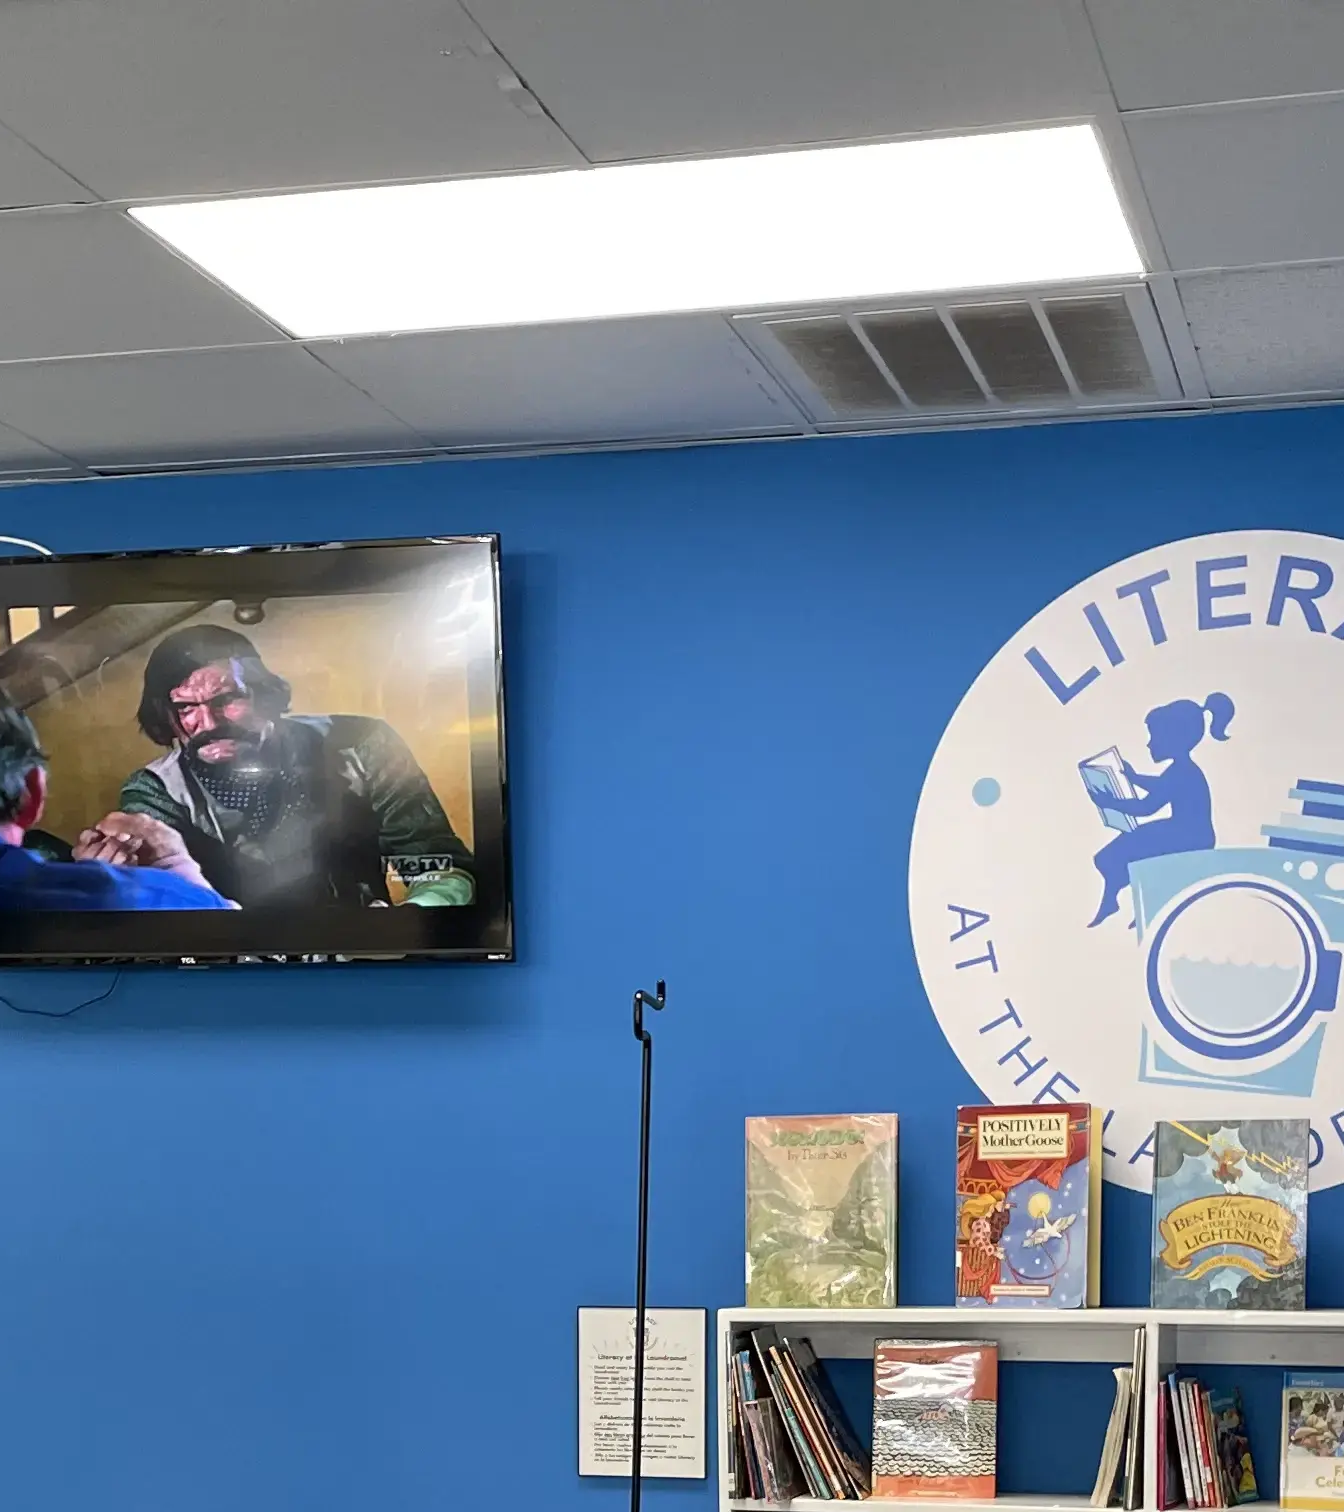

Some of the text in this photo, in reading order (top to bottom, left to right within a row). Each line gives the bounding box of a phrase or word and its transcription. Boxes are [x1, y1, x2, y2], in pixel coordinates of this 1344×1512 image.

[947, 903, 998, 974] AT
[982, 1118, 1064, 1133] POSITIVELY
[982, 1133, 1064, 1147] Mother Goose
[1172, 1211, 1205, 1232] BEN
[1184, 1228, 1277, 1250] LIGHTNING
